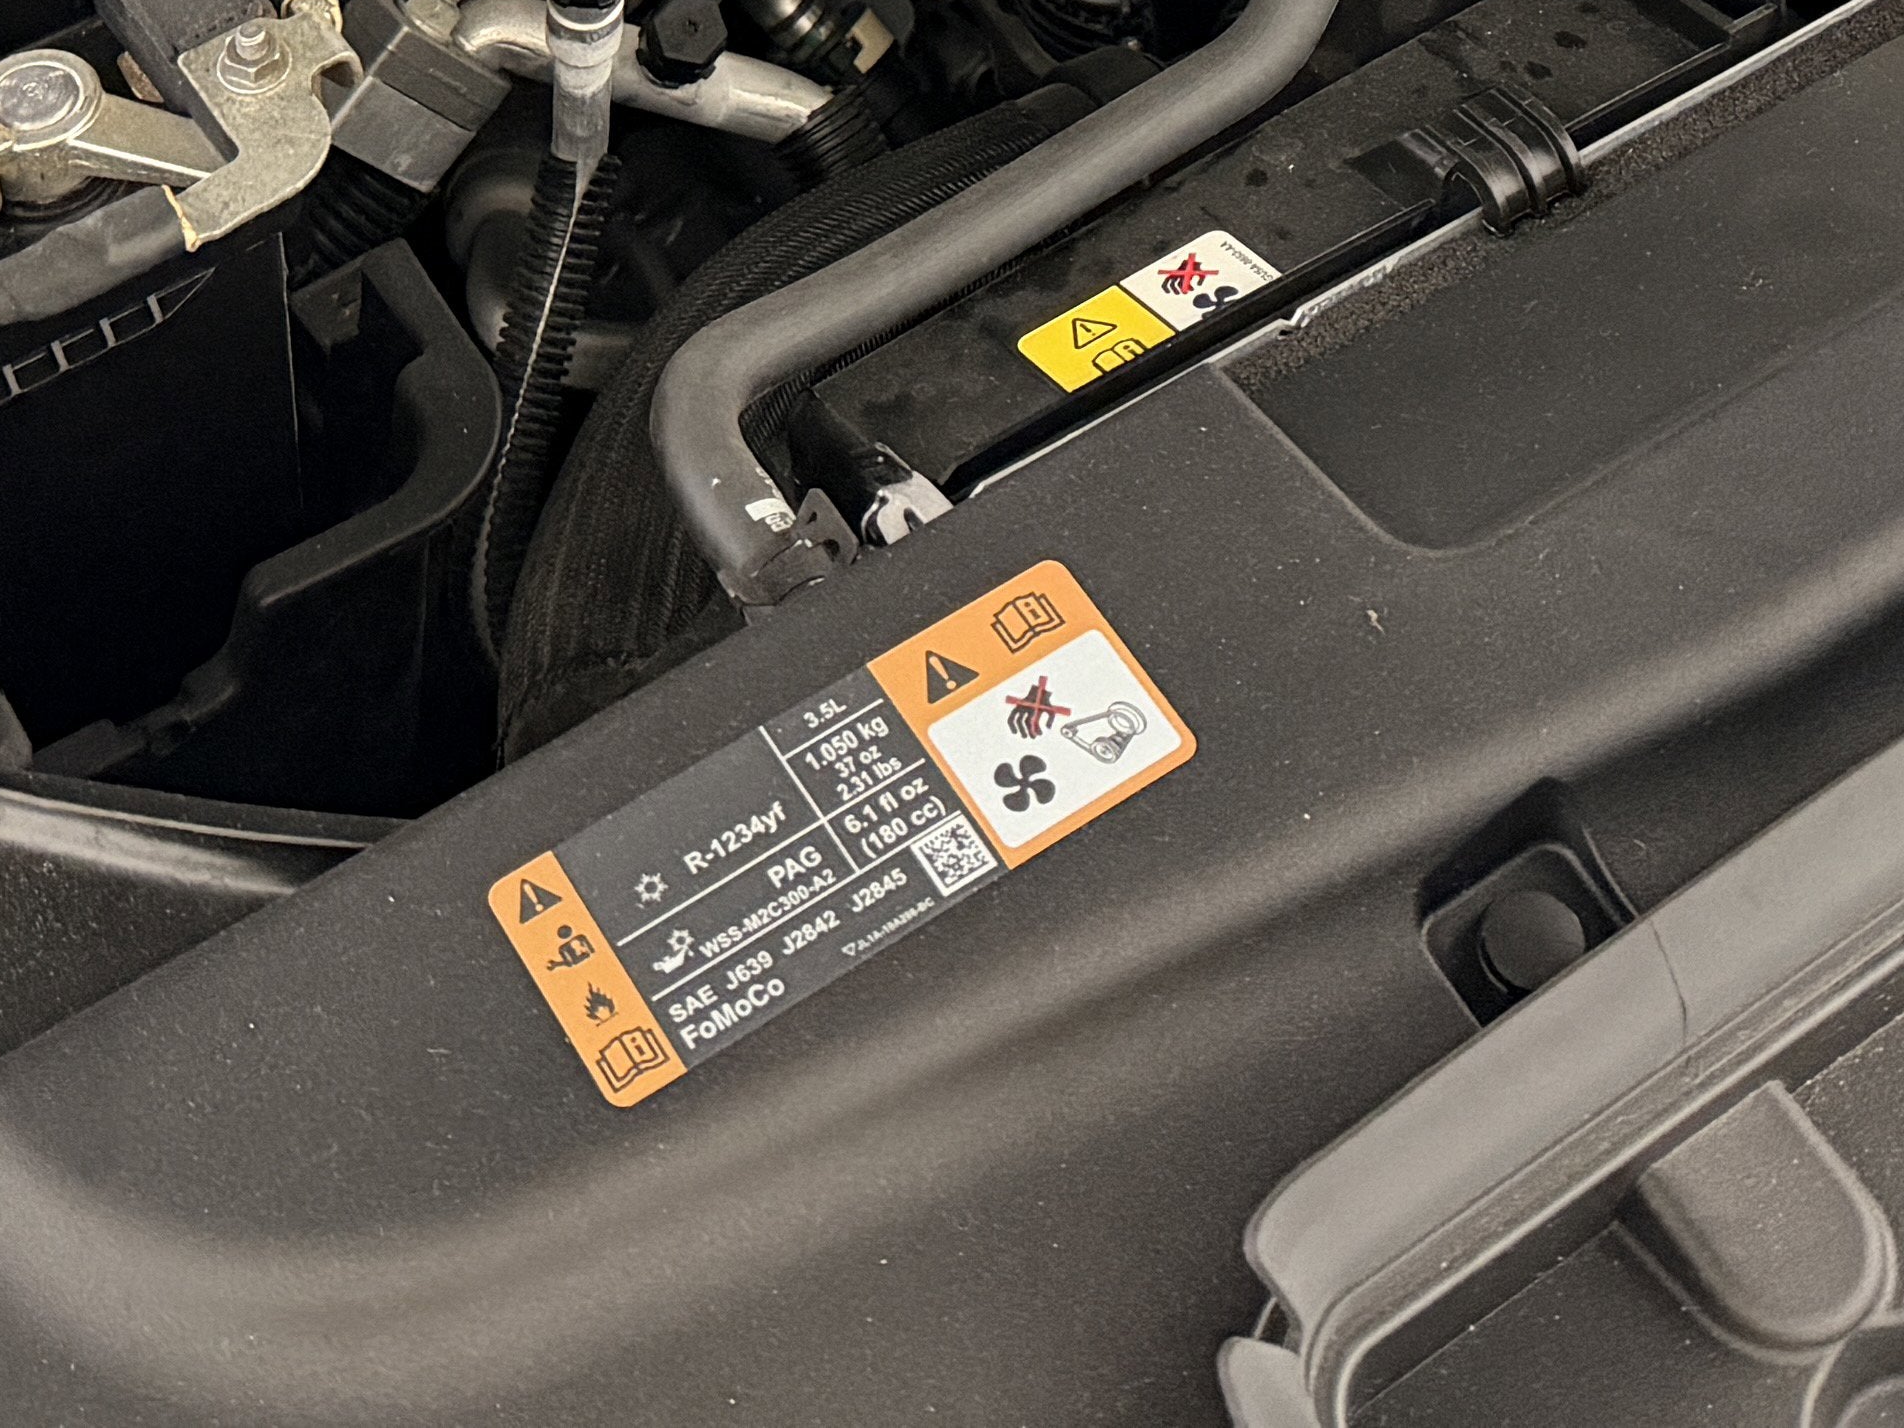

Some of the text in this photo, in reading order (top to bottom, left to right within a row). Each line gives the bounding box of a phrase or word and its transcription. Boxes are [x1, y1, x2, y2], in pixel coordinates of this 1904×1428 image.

[803, 698, 846, 728] 3.5L
[805, 716, 888, 769] 1.050 kg
[834, 745, 881, 777] 37 oz
[836, 757, 901, 800] 2.31 lbs
[843, 777, 928, 833] 6.1 fl oz
[683, 800, 785, 874] R-1234yf
[861, 795, 946, 858] (180 cc)
[766, 845, 821, 888] PAG
[698, 868, 836, 957] WSS-M2C300-A2
[668, 984, 717, 1022] SAE
[726, 950, 772, 989] J639
[782, 910, 840, 954] J2842
[851, 867, 906, 912] J2845
[679, 978, 784, 1049] FoMoCo
